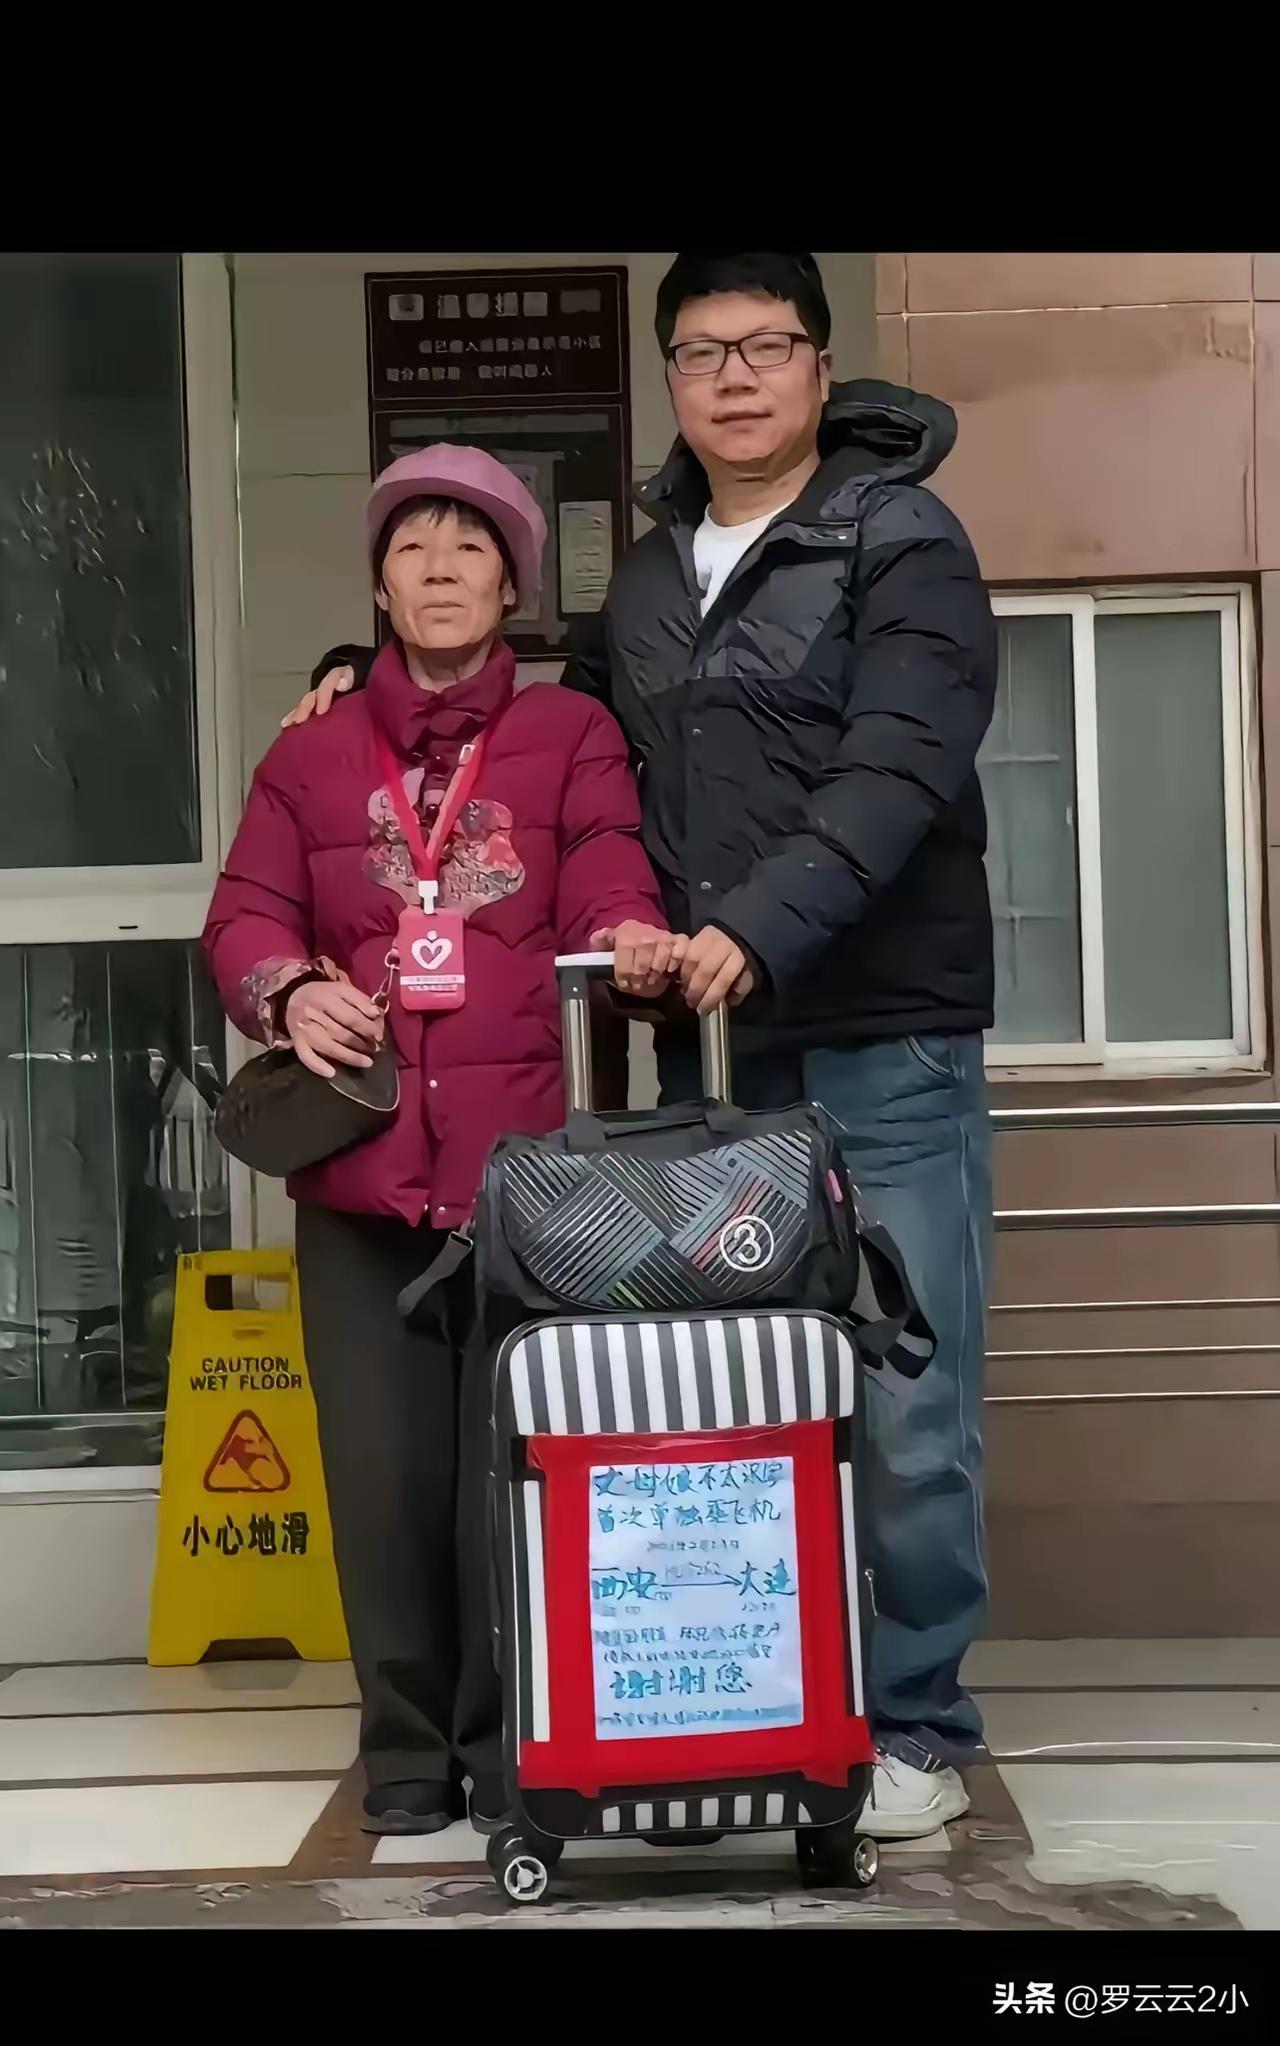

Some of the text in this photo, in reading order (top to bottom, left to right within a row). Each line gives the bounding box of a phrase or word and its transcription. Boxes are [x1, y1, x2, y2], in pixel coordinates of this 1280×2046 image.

[189, 1373, 303, 1391] WET FLOOR
[201, 1356, 289, 1374] CAUTION
[181, 1511, 310, 1557] 小心地滑
[591, 1567, 658, 1601] 西安
[738, 1558, 797, 1598] 大连
[609, 1662, 753, 1699] 谢谢您
